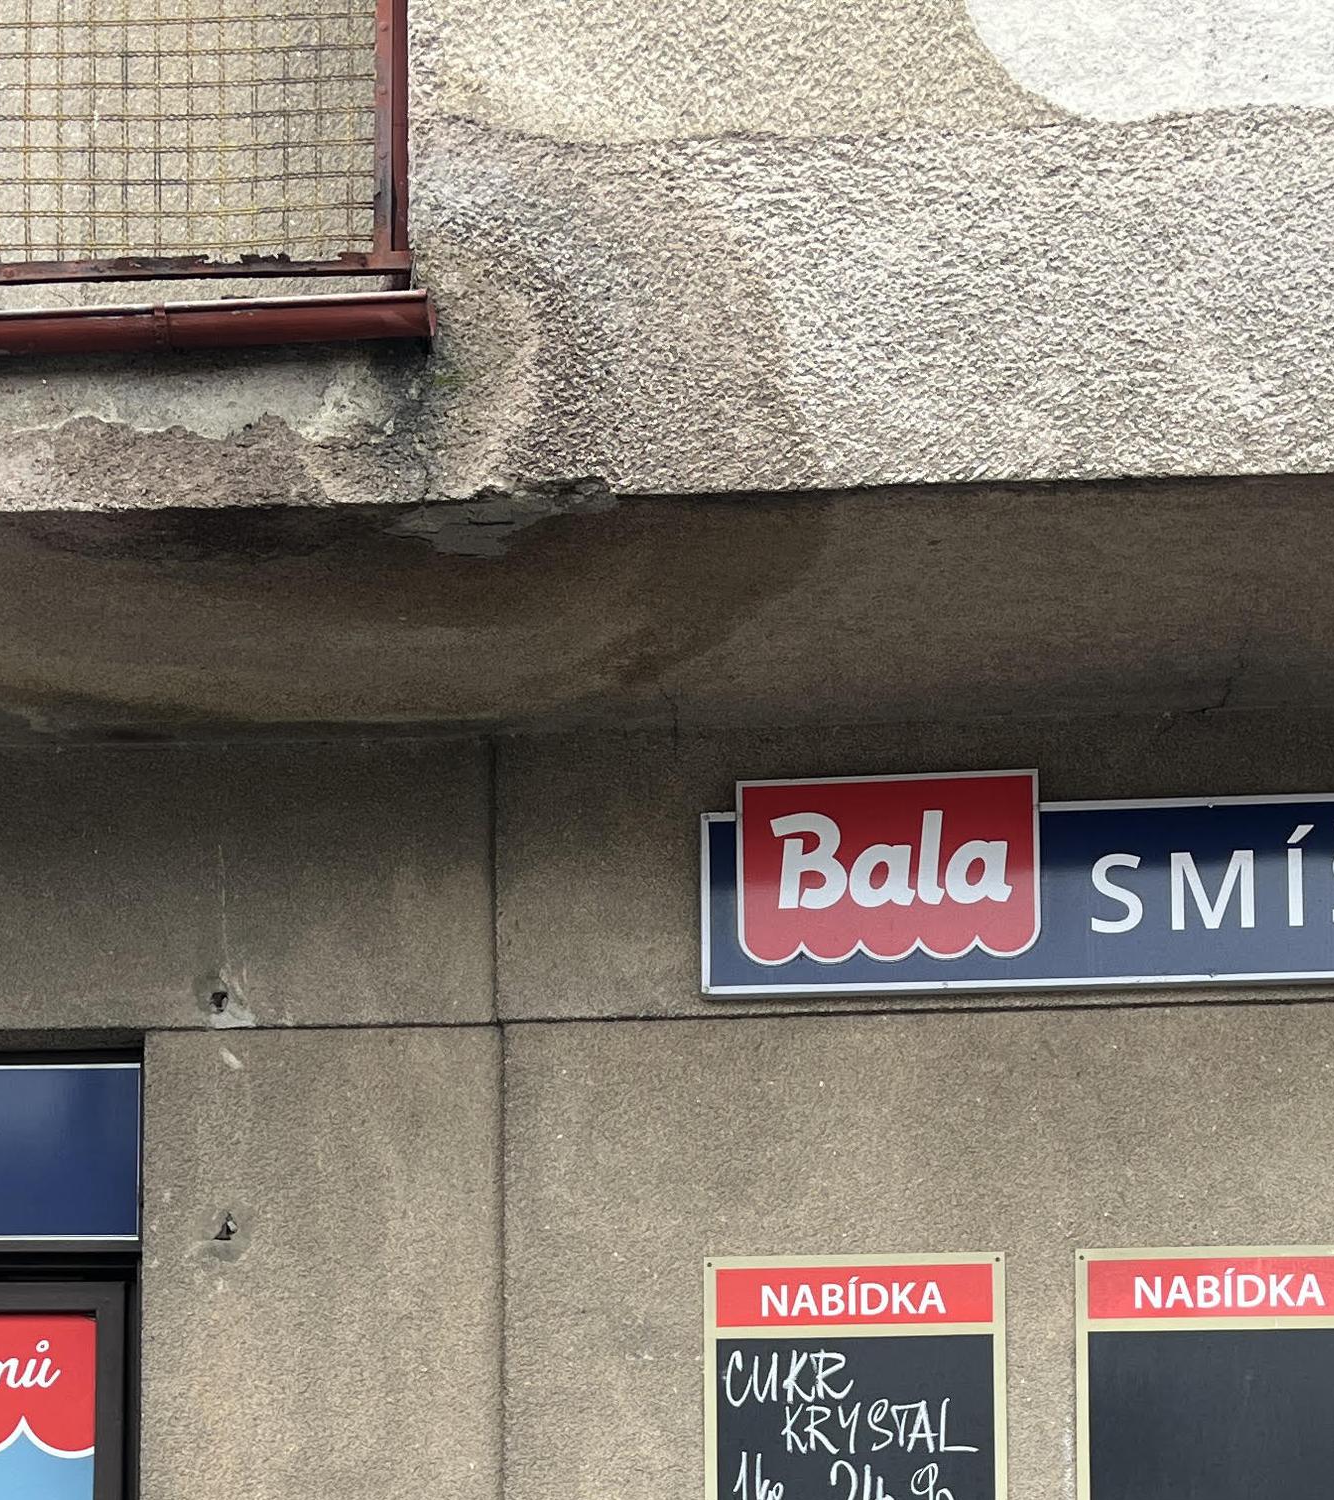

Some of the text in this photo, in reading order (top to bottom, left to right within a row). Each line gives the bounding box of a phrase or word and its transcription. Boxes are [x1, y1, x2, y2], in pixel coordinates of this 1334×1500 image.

[770, 811, 1012, 909] Bala
[761, 1277, 947, 1318] NABÍDKA
[1134, 1268, 1326, 1309] NABÍDKA
[724, 1349, 854, 1408] CUKR
[781, 1397, 980, 1455] KRYSTAL
